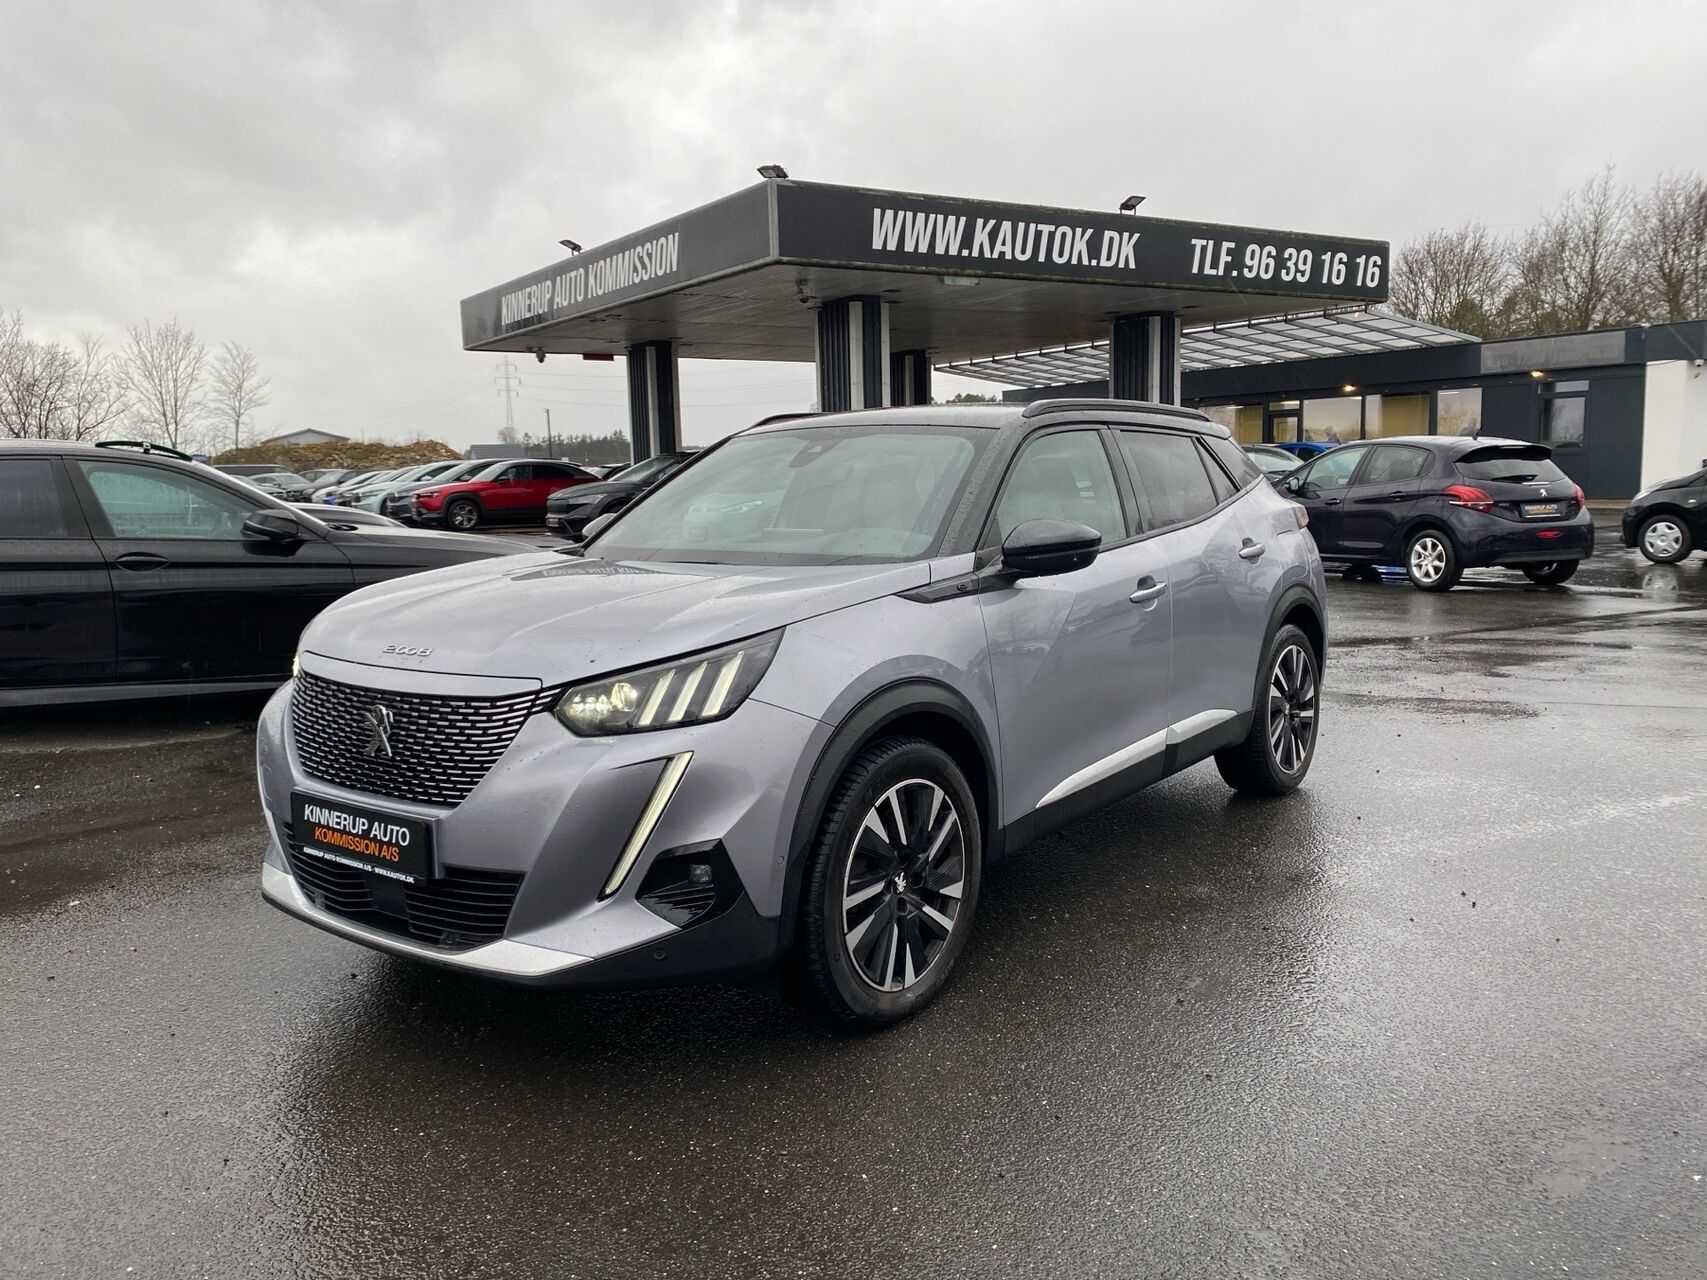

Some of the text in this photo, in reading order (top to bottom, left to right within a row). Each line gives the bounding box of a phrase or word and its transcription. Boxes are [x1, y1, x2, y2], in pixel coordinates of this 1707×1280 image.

[872, 207, 1141, 269] WWW.KAUTOK.DK
[1190, 238, 1382, 288] TLF. 96 39 16 16
[501, 232, 680, 326] KINNERUP AUTO KOMMISSION
[304, 803, 410, 847] KINNERUP AUTO
[314, 826, 399, 862] KOMMISSION A/S
